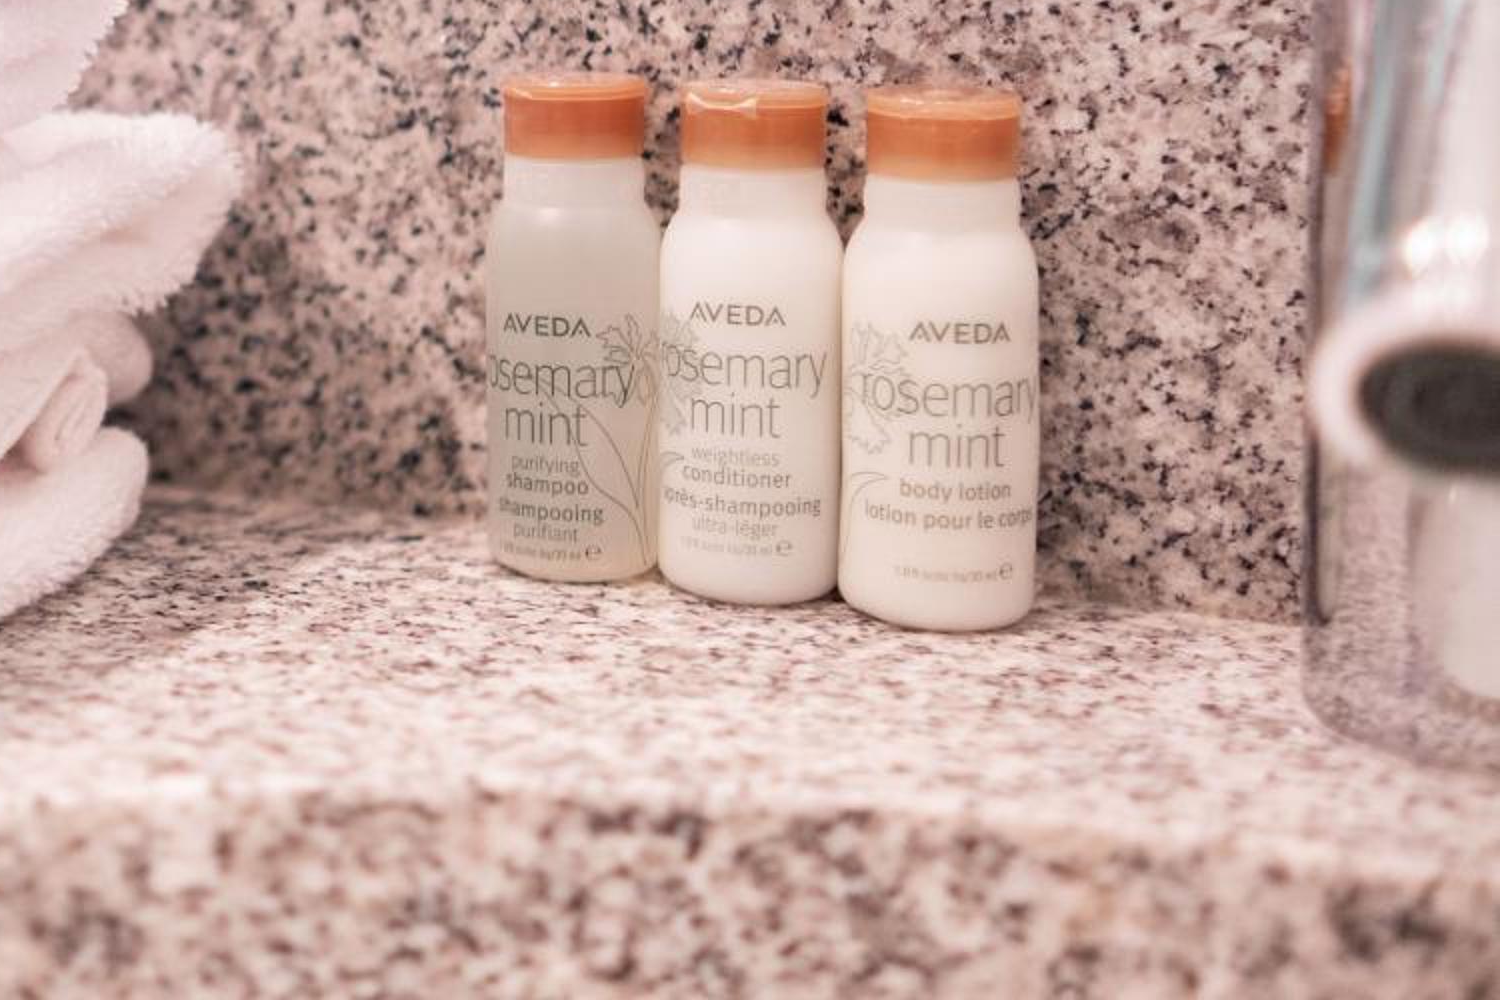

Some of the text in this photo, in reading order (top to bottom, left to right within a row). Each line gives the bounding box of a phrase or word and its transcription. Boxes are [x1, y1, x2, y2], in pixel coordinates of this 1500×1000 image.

[503, 312, 592, 338] AVEDA
[689, 301, 787, 327] AVEDA
[908, 320, 1012, 345] AVEDA
[488, 354, 636, 409] osemary
[505, 401, 589, 446] mint
[690, 391, 782, 439] mint
[691, 447, 782, 468] weightless
[907, 422, 1007, 469] mint
[511, 455, 581, 478] purifying
[681, 464, 793, 489] conditioner
[505, 472, 590, 497] shampoo
[900, 480, 1012, 505] body lotion
[864, 499, 918, 527] lotion
[922, 512, 973, 533] pour
[977, 509, 994, 530] le
[513, 523, 579, 544] purifiant
